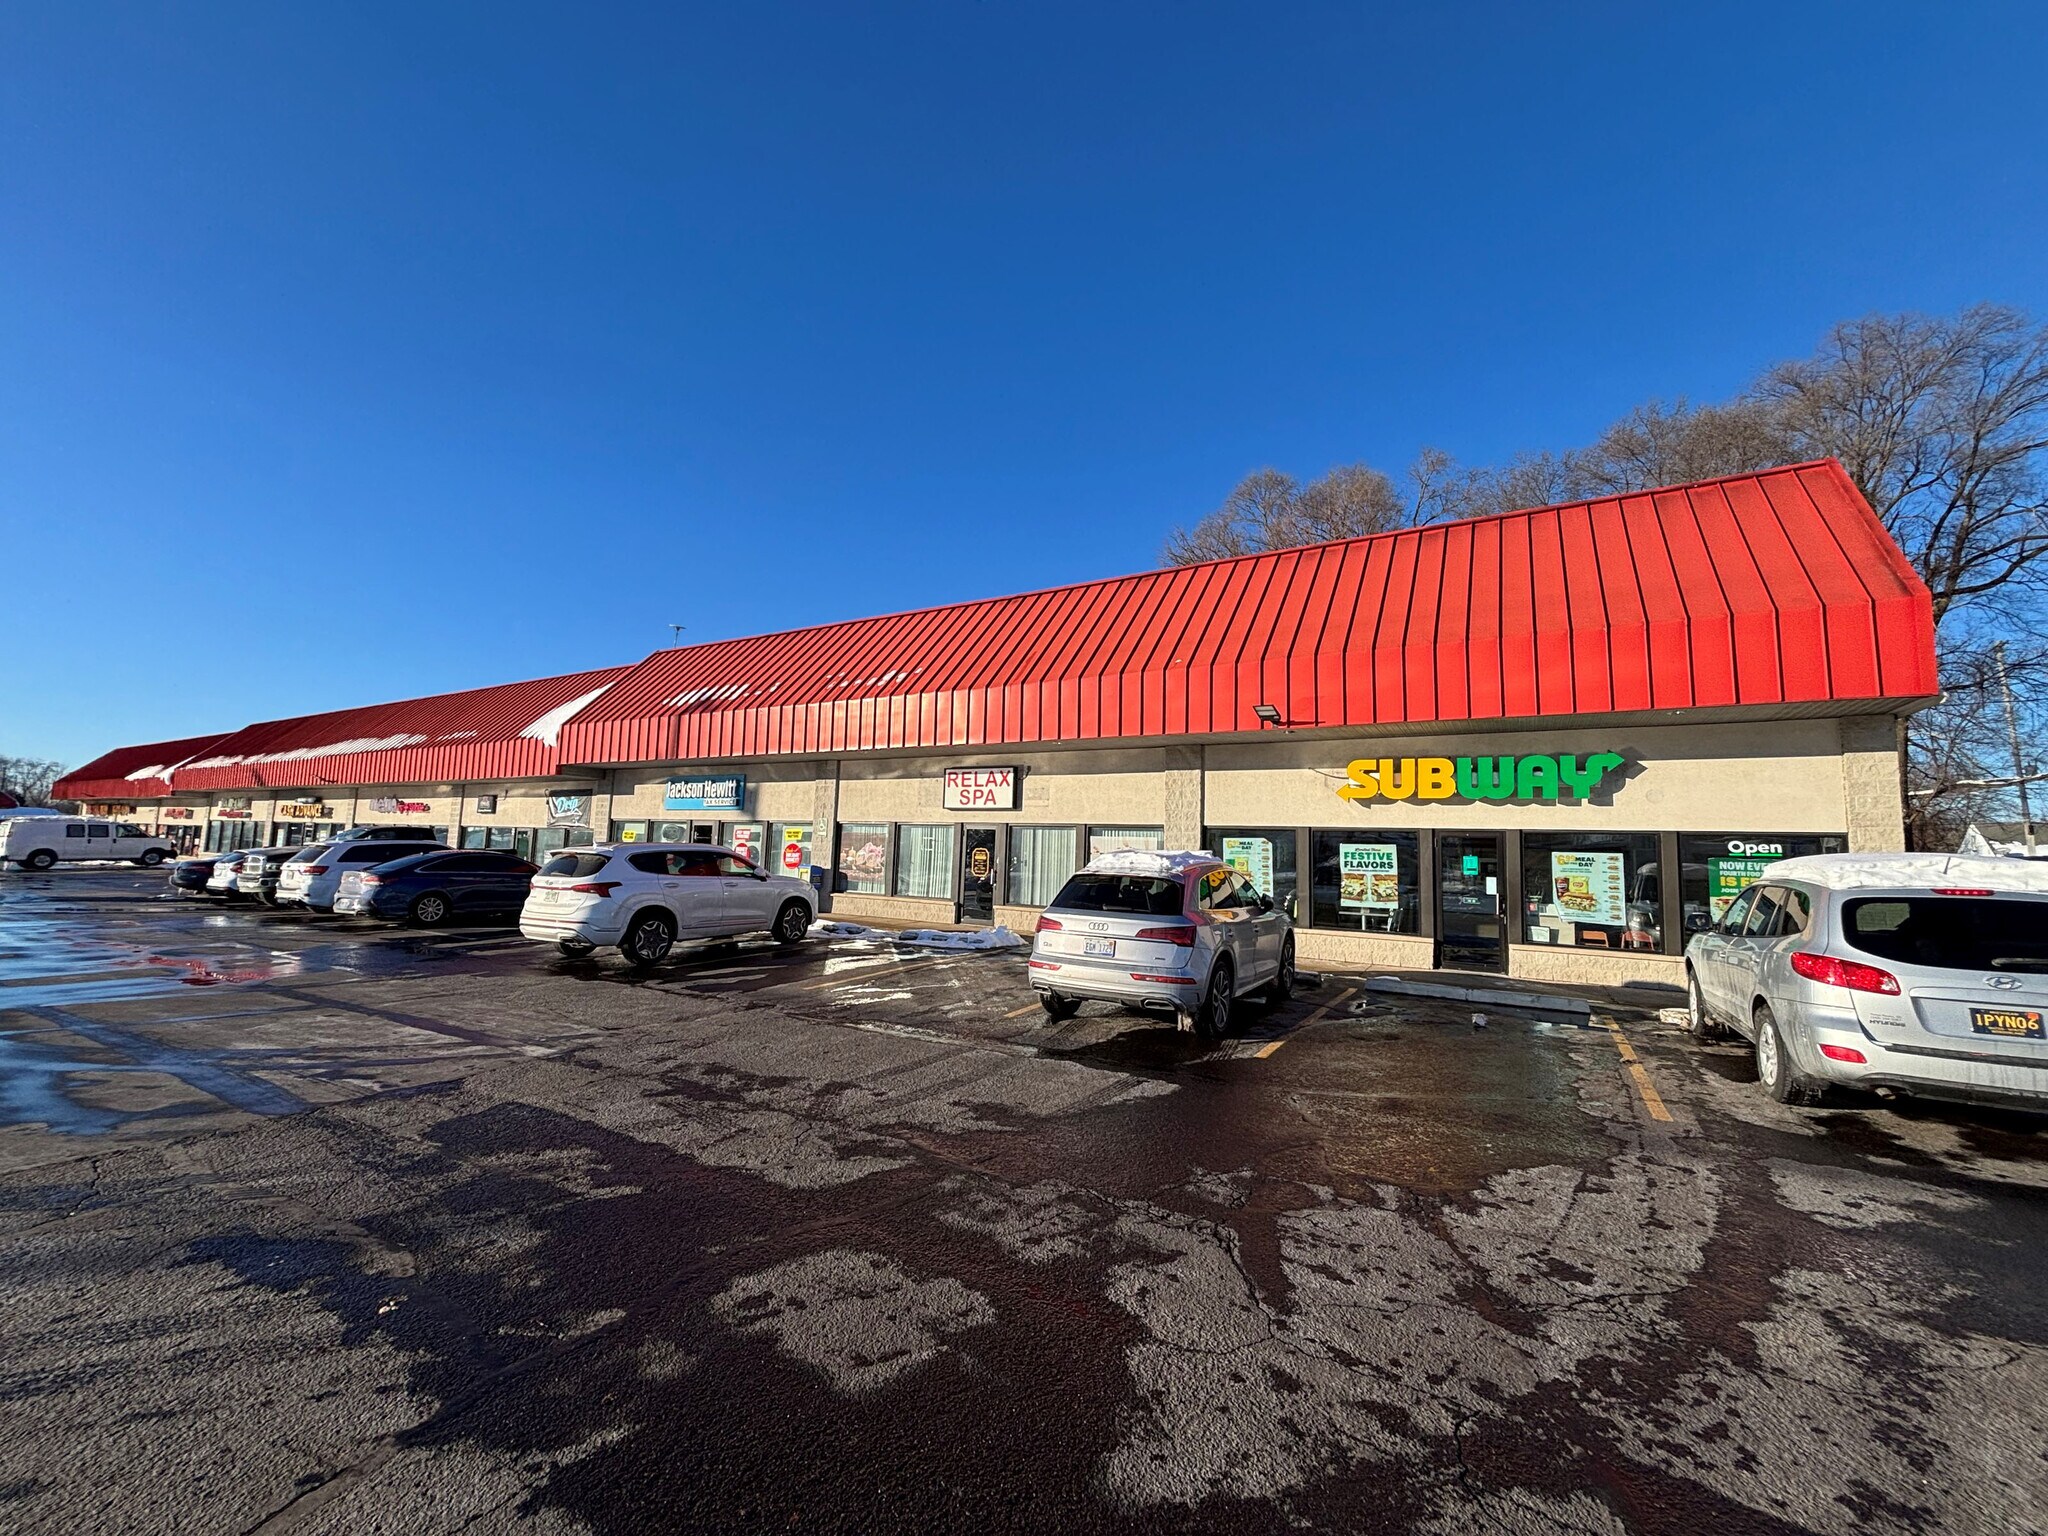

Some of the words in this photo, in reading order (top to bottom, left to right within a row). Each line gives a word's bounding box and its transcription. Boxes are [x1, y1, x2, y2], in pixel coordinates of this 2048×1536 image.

[947, 769, 1011, 788] RELAX
[1336, 751, 1625, 800] SUBWAY
[665, 780, 704, 799] Jackson
[703, 779, 737, 799] Hewitt
[959, 789, 997, 806] SPA
[1343, 851, 1393, 861] FESTIVE
[1727, 840, 1783, 857] Open
[1343, 860, 1394, 870] FLAVORS
[1718, 861, 1746, 870] NOW
[1719, 876, 1738, 887] IS
[1975, 1013, 2039, 1030] 1PYN06
